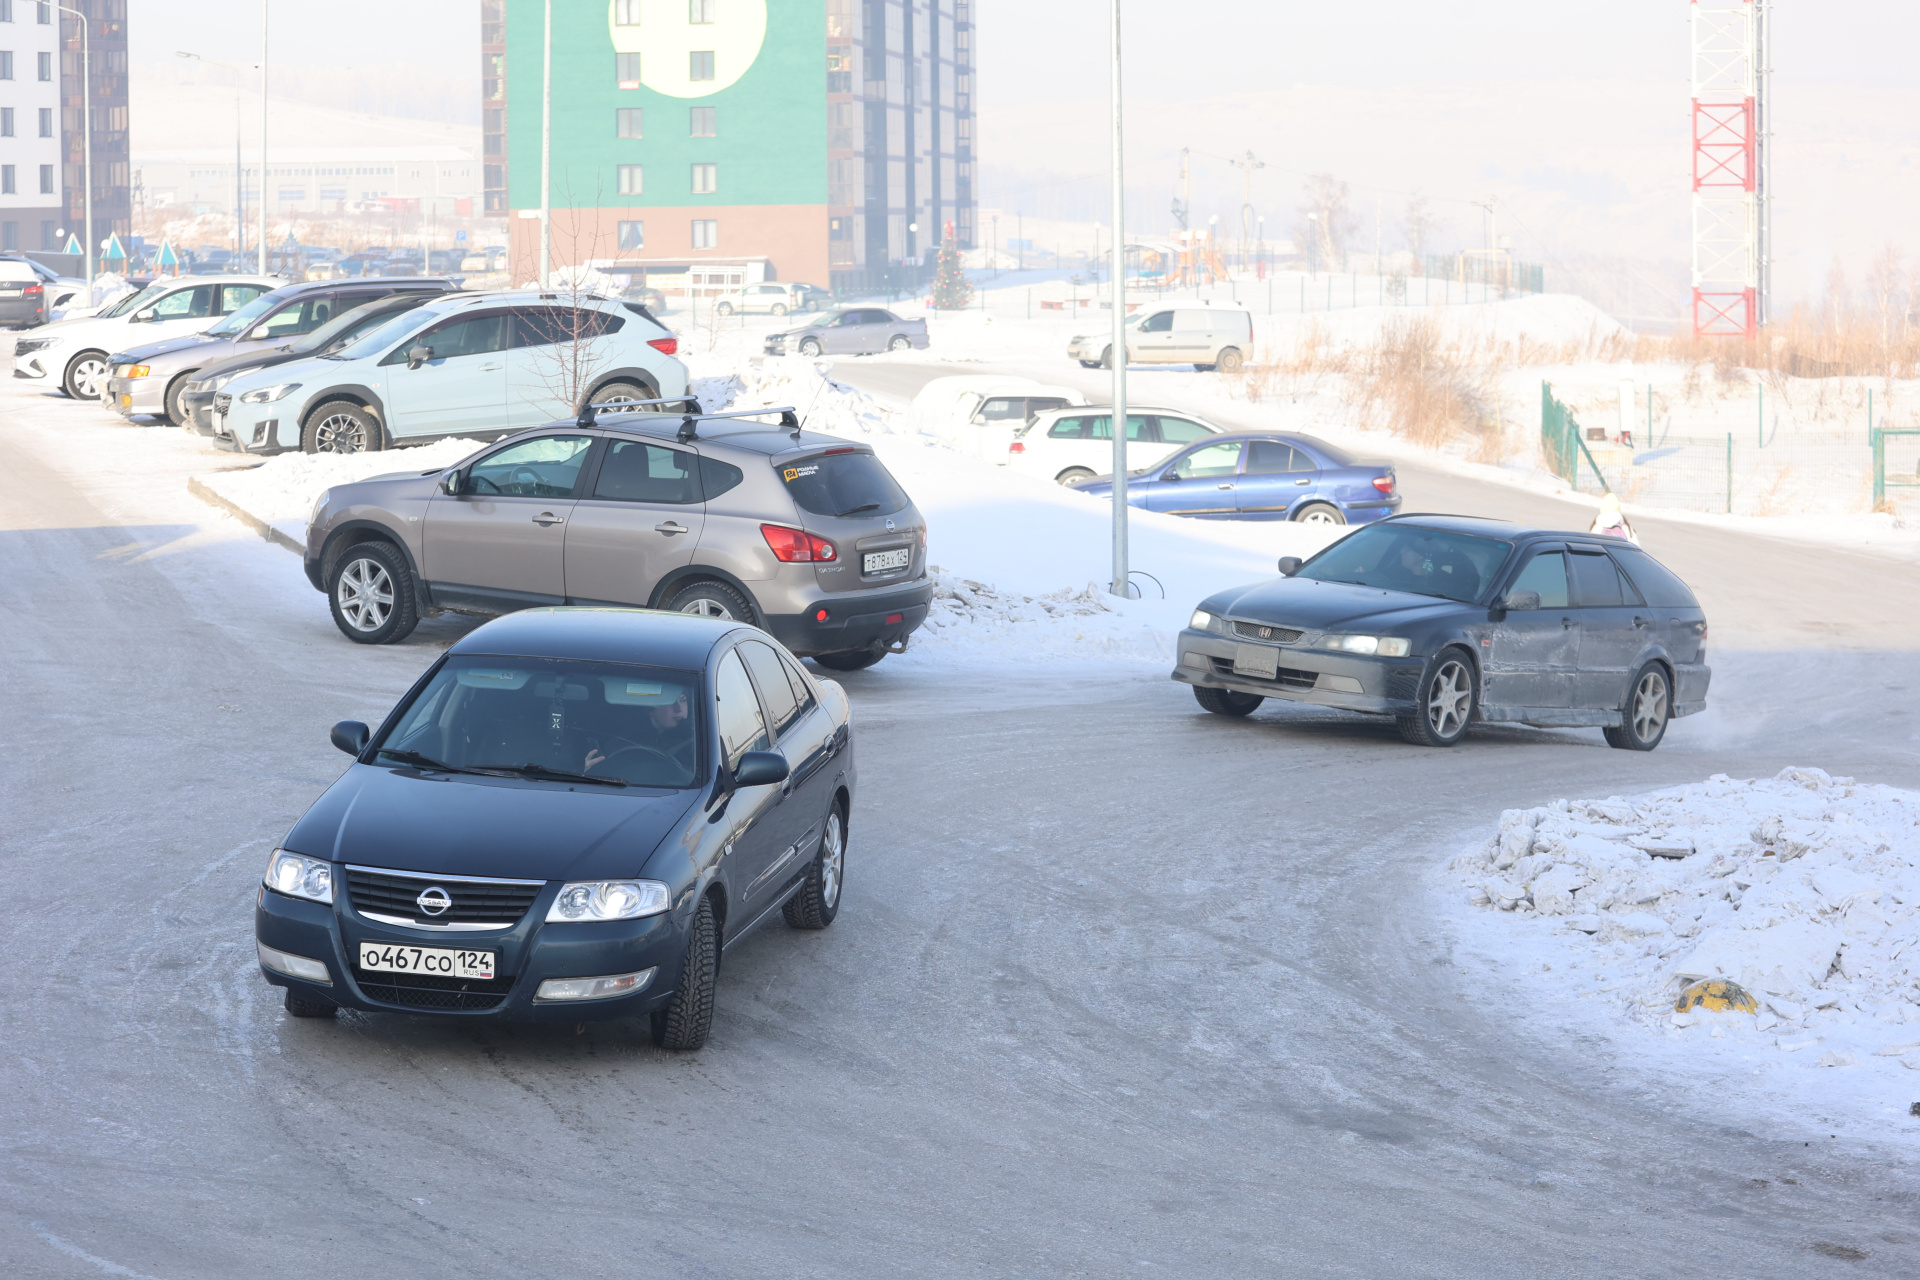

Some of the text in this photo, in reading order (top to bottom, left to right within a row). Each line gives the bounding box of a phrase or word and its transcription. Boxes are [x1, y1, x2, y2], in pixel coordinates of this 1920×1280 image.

[420, 898, 448, 906] NISSAN
[366, 947, 489, 972] О467СО 124
[463, 968, 479, 976] RUS
